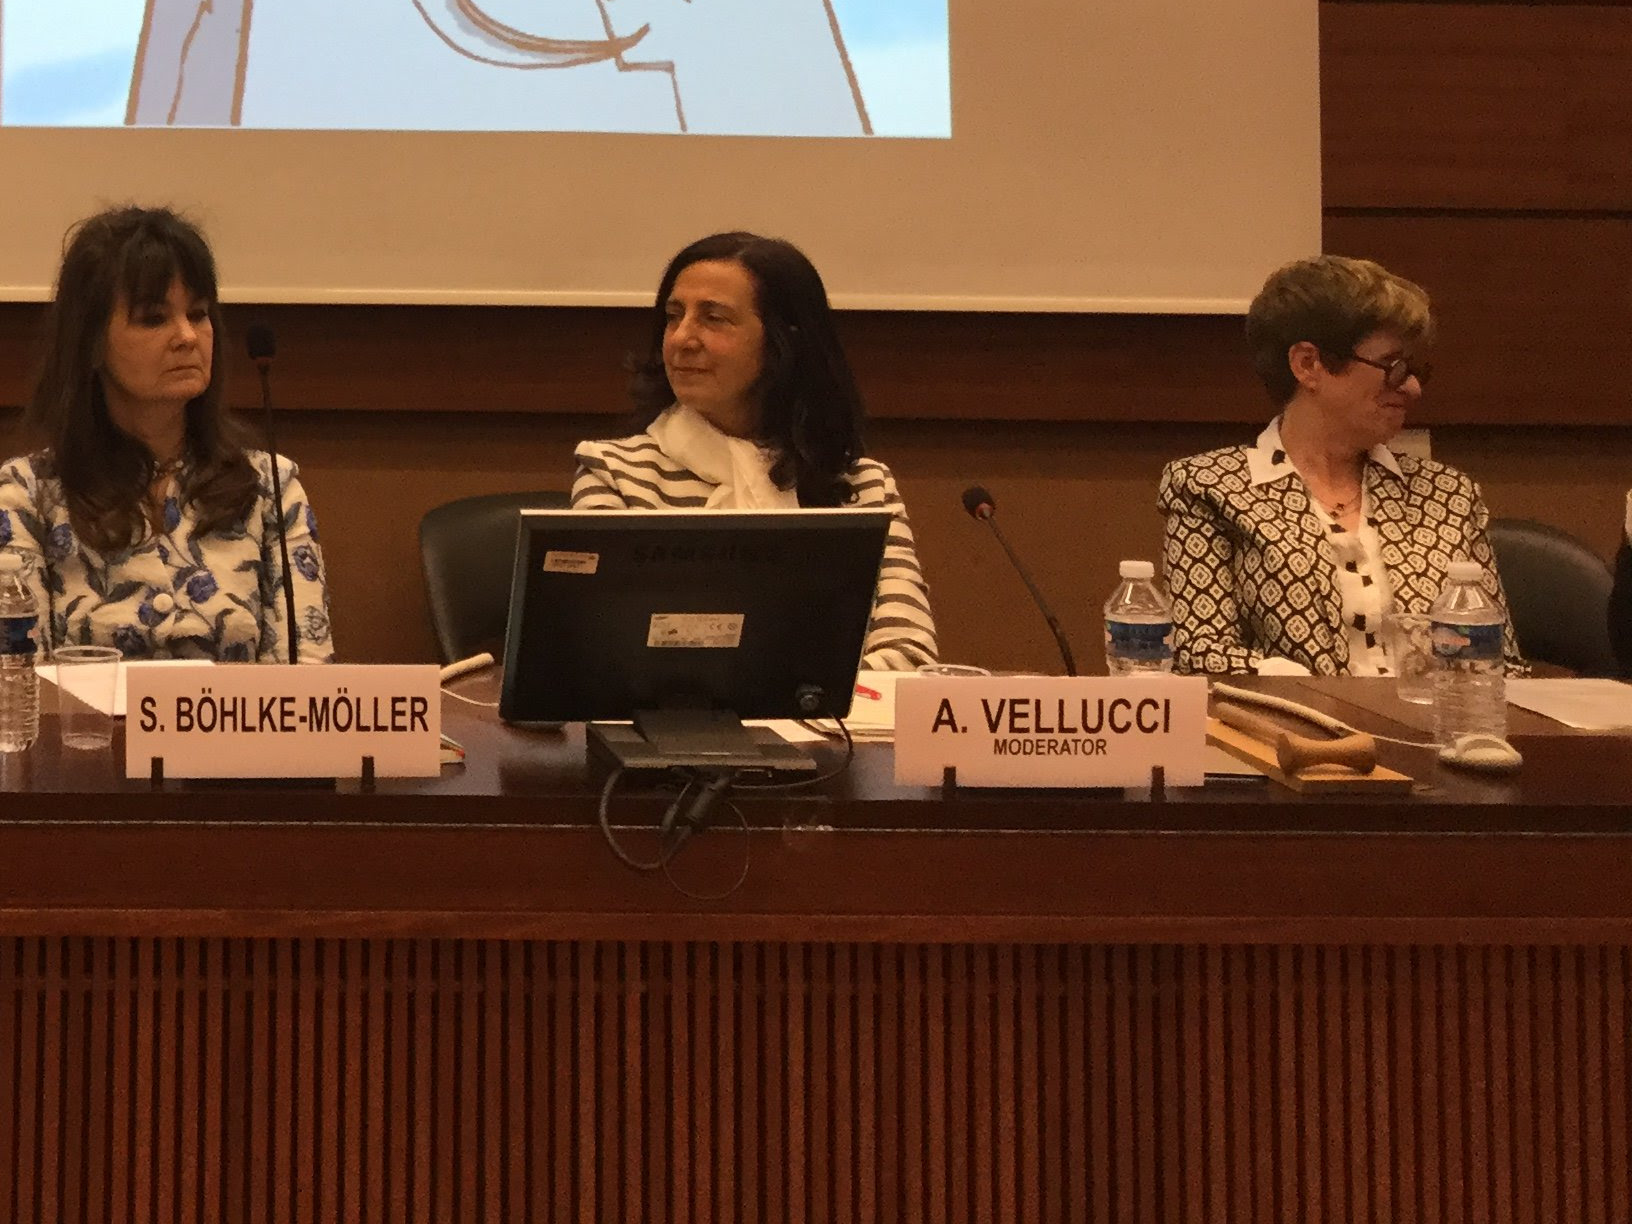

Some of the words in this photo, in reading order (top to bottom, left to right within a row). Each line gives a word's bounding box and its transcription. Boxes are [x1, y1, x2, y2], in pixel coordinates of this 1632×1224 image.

[140, 697, 165, 732] S.
[176, 687, 429, 733] BÖHLKE-MÖLLER
[932, 698, 968, 733] A.
[981, 698, 1171, 734] VELLUCCI
[994, 739, 1107, 756] MODERATOR
